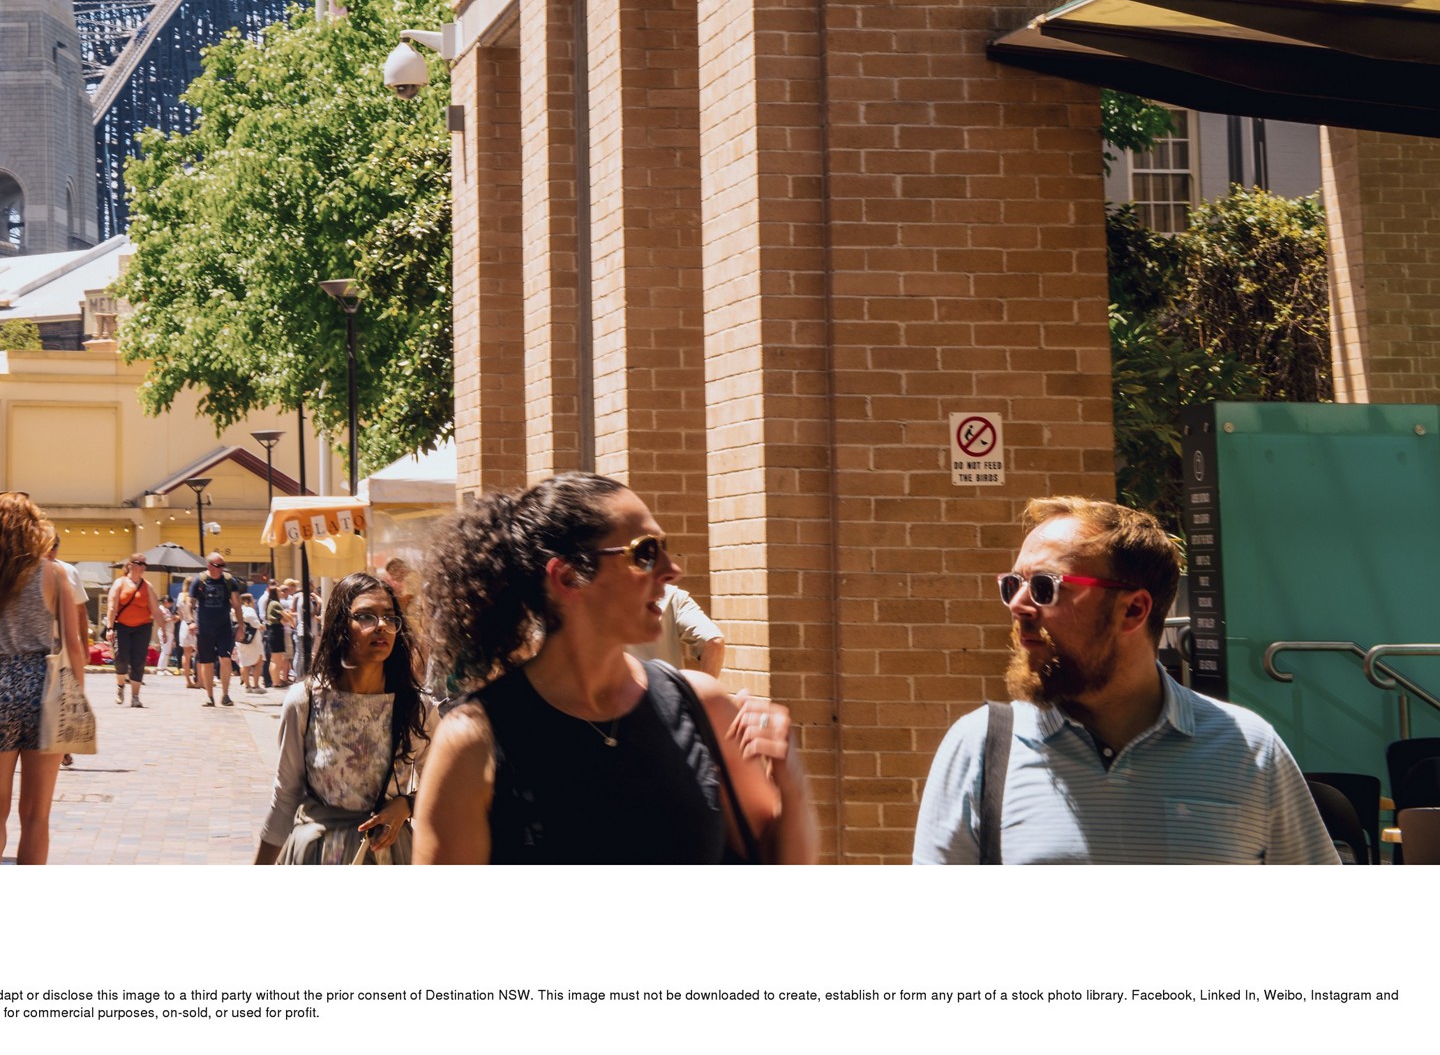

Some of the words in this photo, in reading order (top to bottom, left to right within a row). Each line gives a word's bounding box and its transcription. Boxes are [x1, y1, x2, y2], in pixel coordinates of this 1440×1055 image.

[954, 461, 963, 470] DO
[967, 461, 980, 470] NOT
[984, 461, 1002, 470] FEED
[959, 474, 973, 482] THE
[976, 474, 998, 482] BIRDS
[288, 514, 365, 540] GELATO
